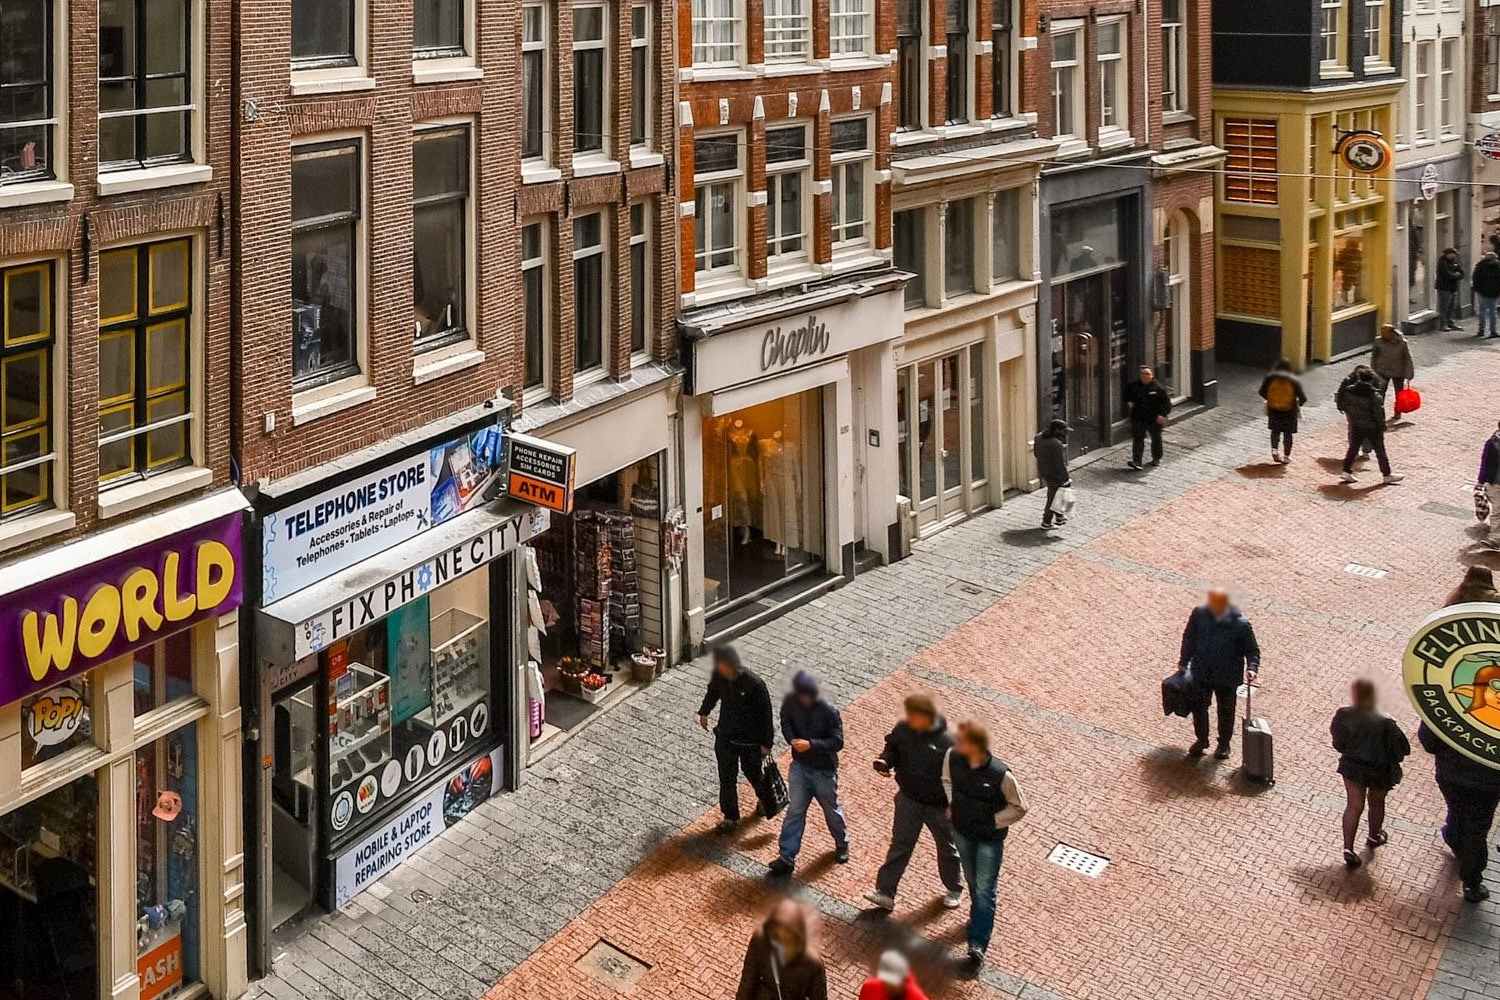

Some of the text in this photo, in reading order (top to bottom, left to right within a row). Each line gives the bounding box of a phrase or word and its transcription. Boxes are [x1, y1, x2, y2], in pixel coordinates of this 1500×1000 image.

[761, 315, 830, 372] Chaplin
[514, 446, 563, 466] PHONE REPAIR
[515, 454, 561, 472] ACCESSORIES
[520, 462, 556, 478] SIM CARDS
[284, 462, 425, 540] TELEPHONE STORE
[518, 481, 556, 503] ATM
[296, 541, 345, 568] Telephones
[350, 523, 380, 544] Tablets
[384, 508, 415, 529] Laptops
[309, 498, 404, 549] Accessories & Repair of
[332, 590, 375, 640] FIX
[470, 515, 523, 565] CITY
[19, 539, 237, 682] WORLD
[31, 696, 83, 737] POP!
[354, 802, 432, 868] MOBILE & LAPTOP
[355, 820, 431, 888] REPAIRING STORE
